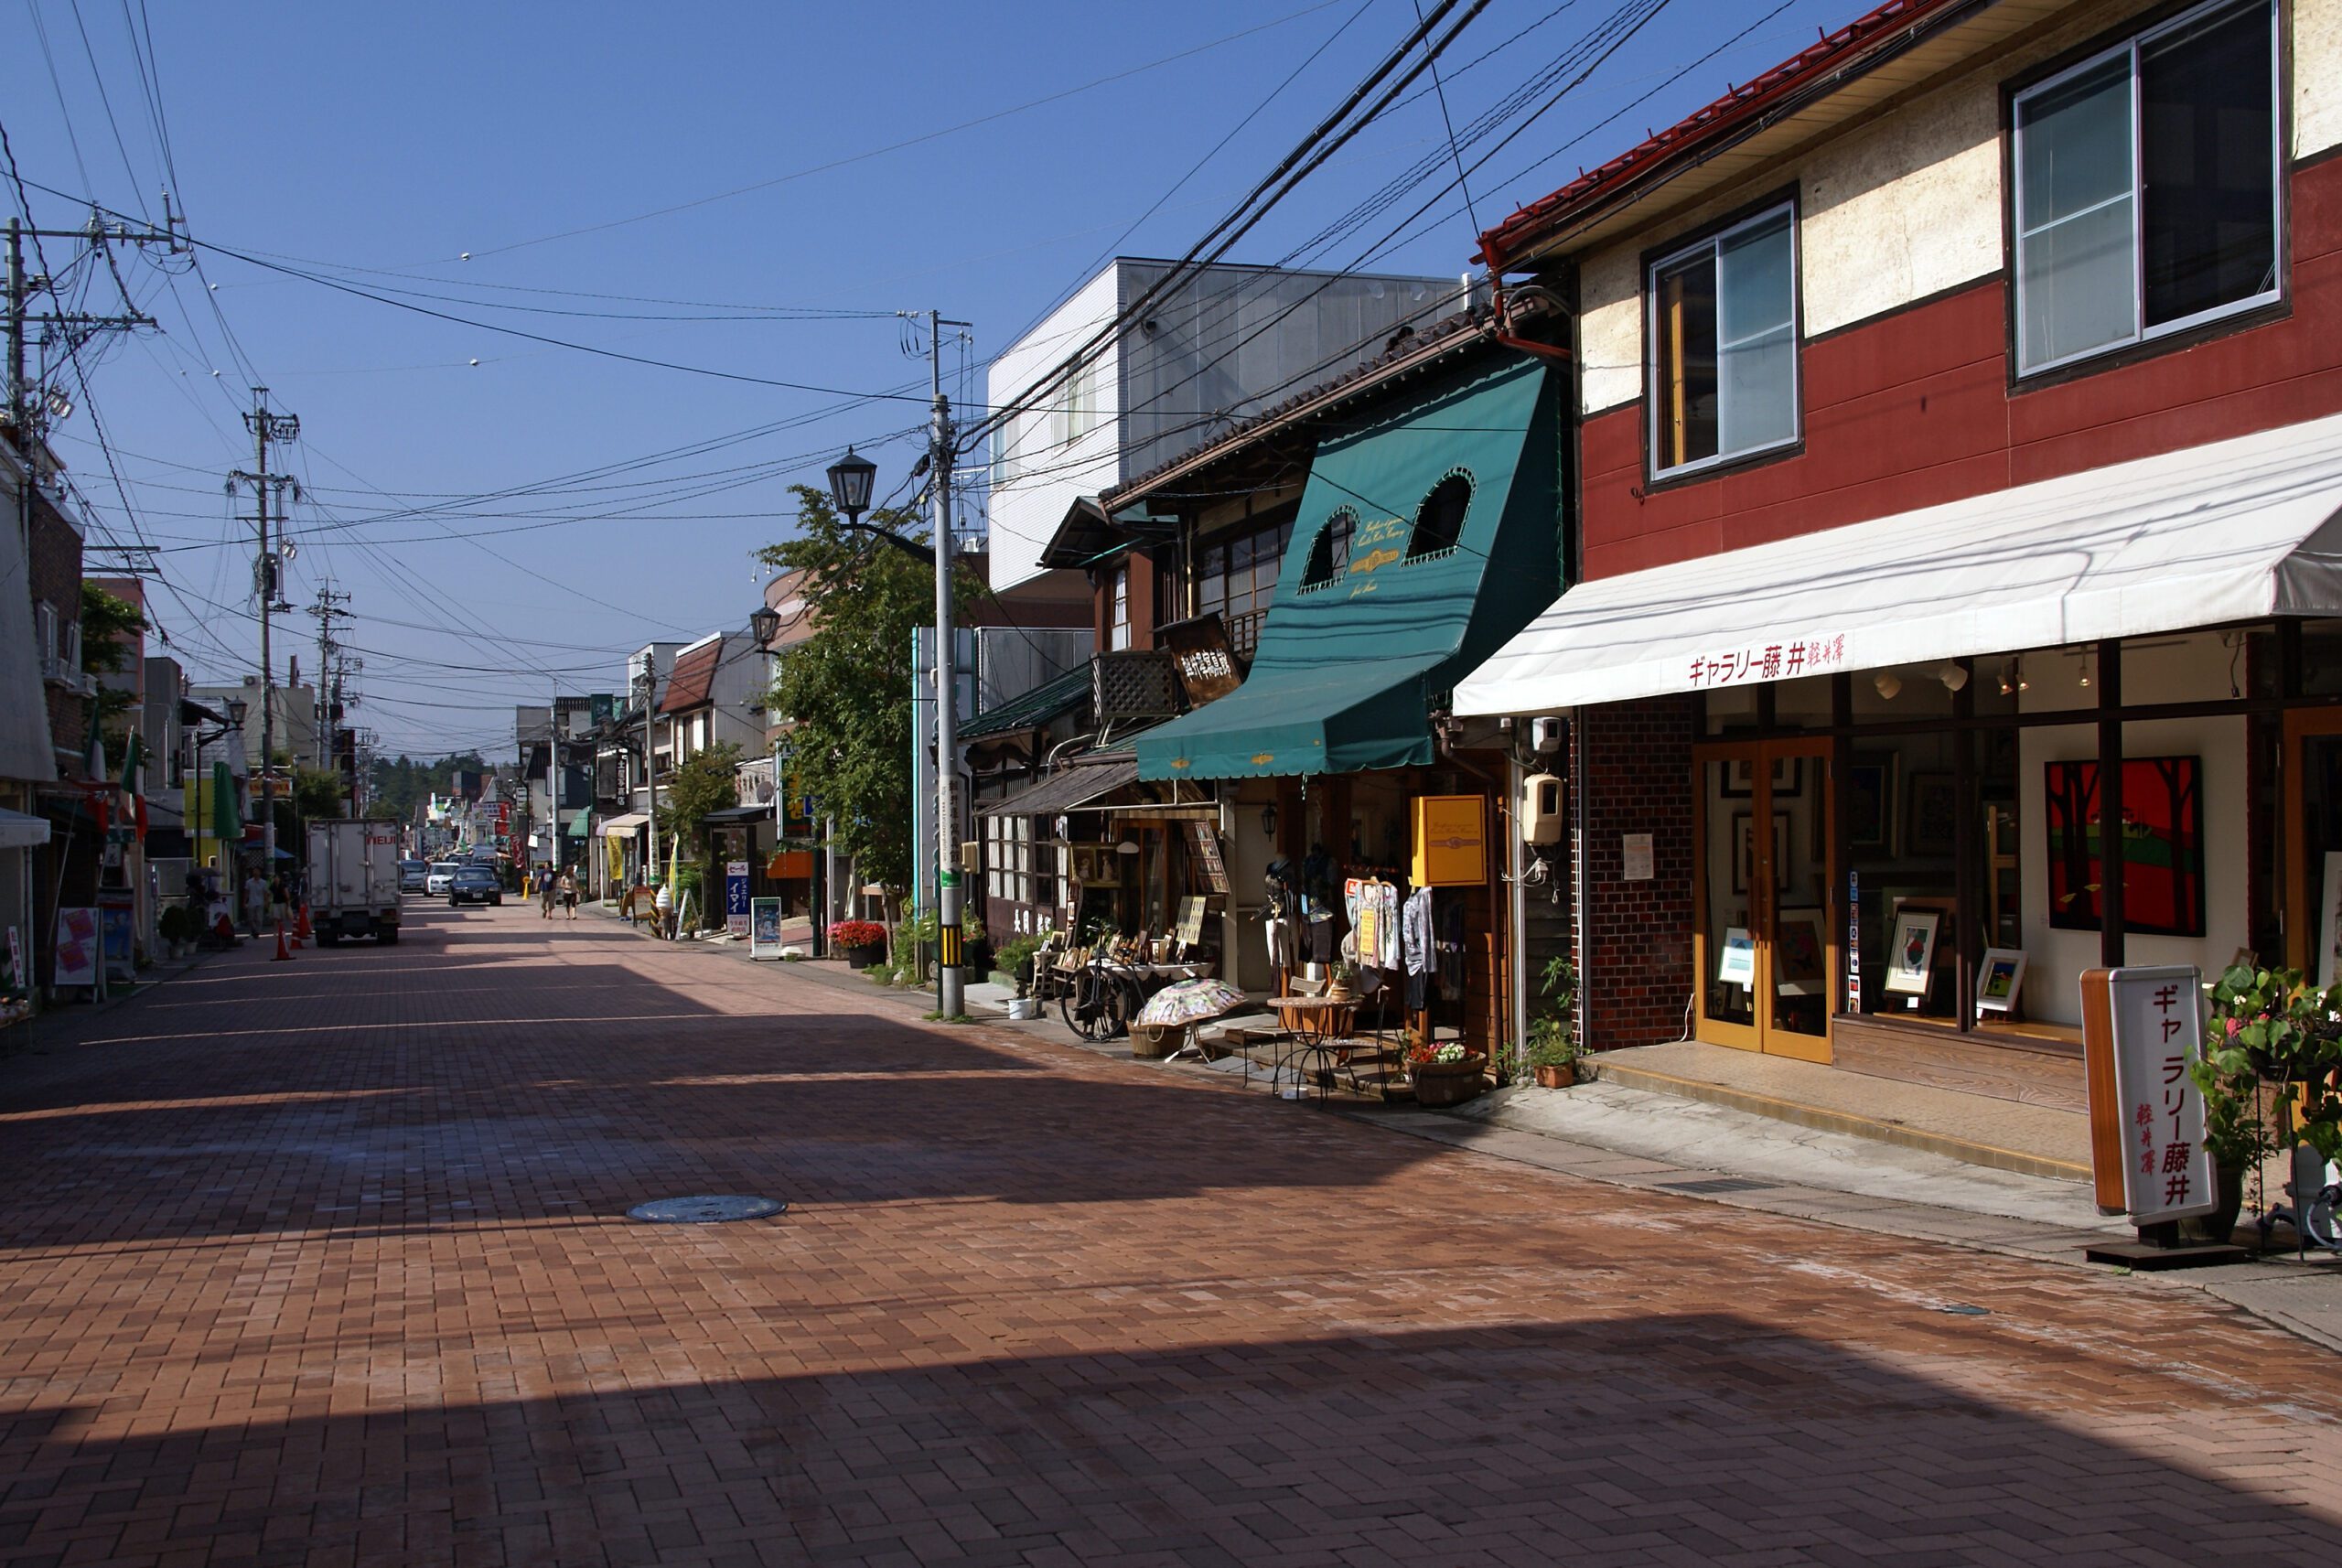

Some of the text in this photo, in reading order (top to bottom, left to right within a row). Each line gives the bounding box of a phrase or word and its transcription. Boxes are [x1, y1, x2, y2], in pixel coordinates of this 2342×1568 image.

[1690, 641, 1806, 686] ギャラリー藤井
[730, 883, 739, 913] イマイ
[2154, 984, 2191, 1206] ギャラリー藤井
